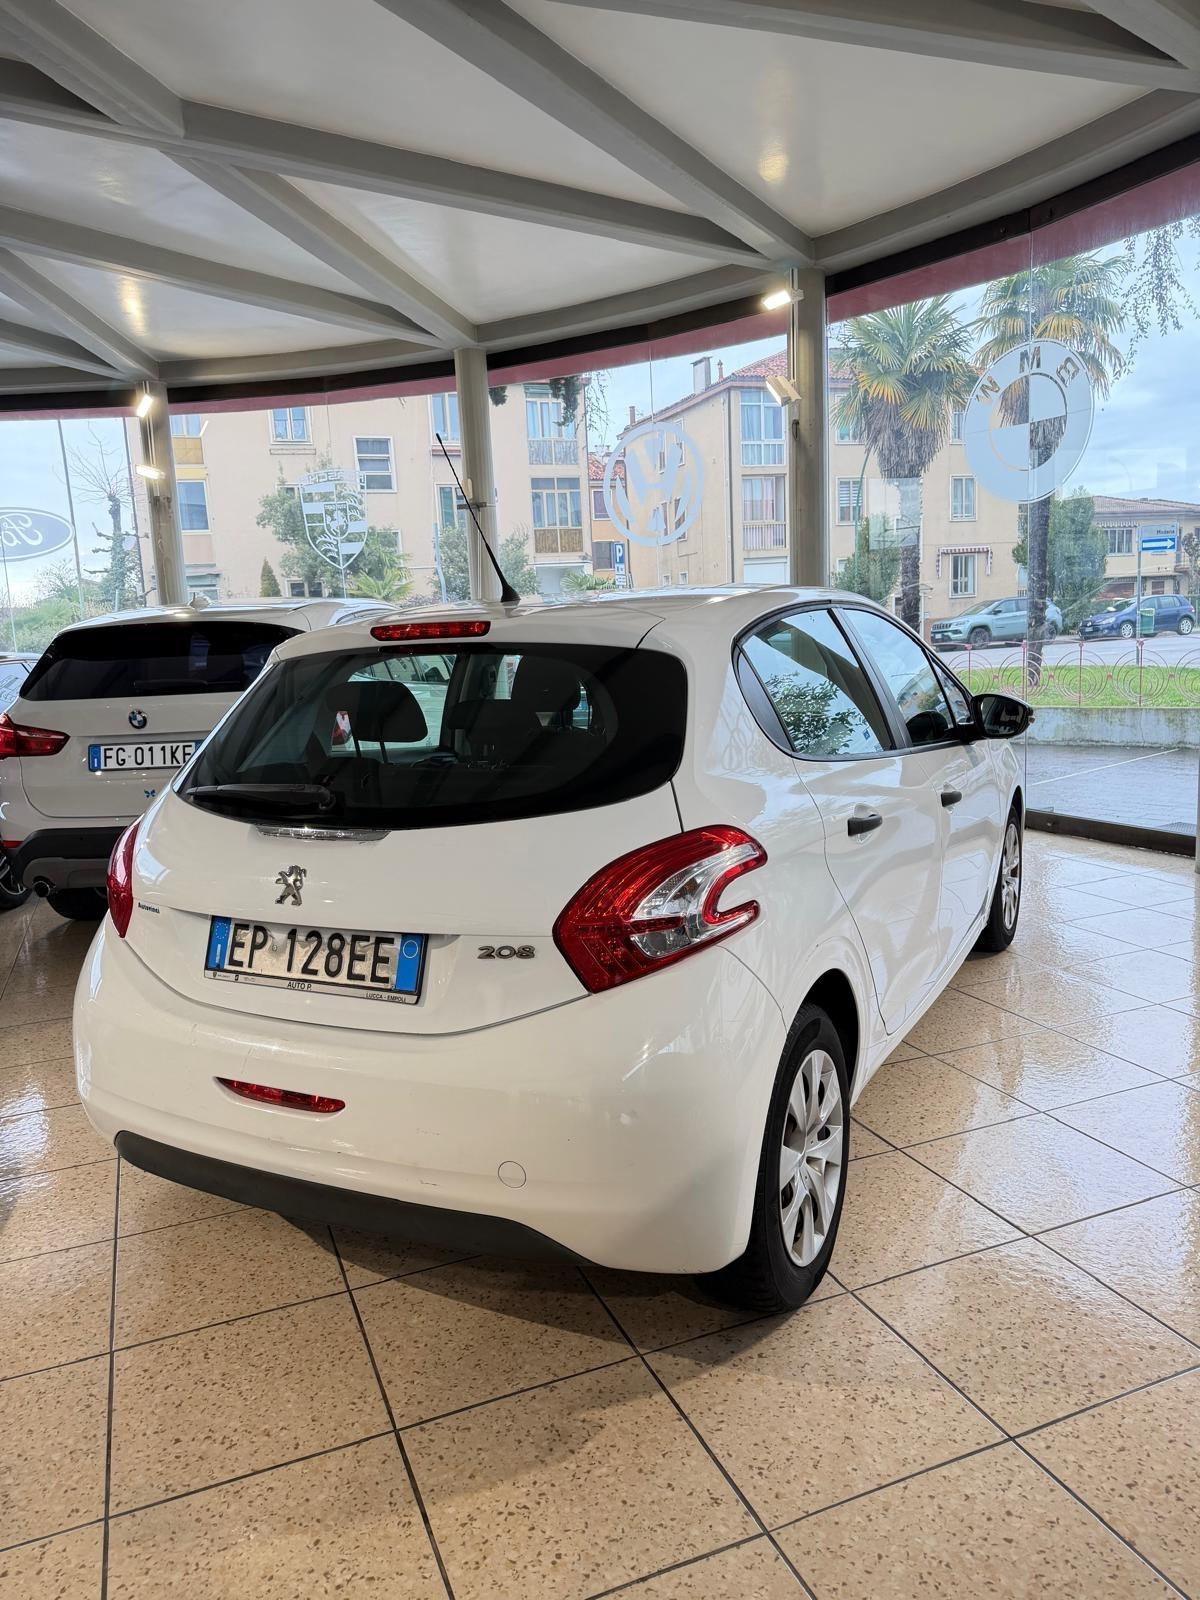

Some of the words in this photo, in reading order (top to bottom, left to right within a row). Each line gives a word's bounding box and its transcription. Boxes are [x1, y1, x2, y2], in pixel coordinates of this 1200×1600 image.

[616, 545, 624, 563] P
[286, 929, 395, 984] 128EE
[477, 944, 536, 959] 208
[287, 981, 306, 990] AUTO
[366, 992, 383, 1000] LUCCA
[387, 994, 406, 1003] EMPOLI
